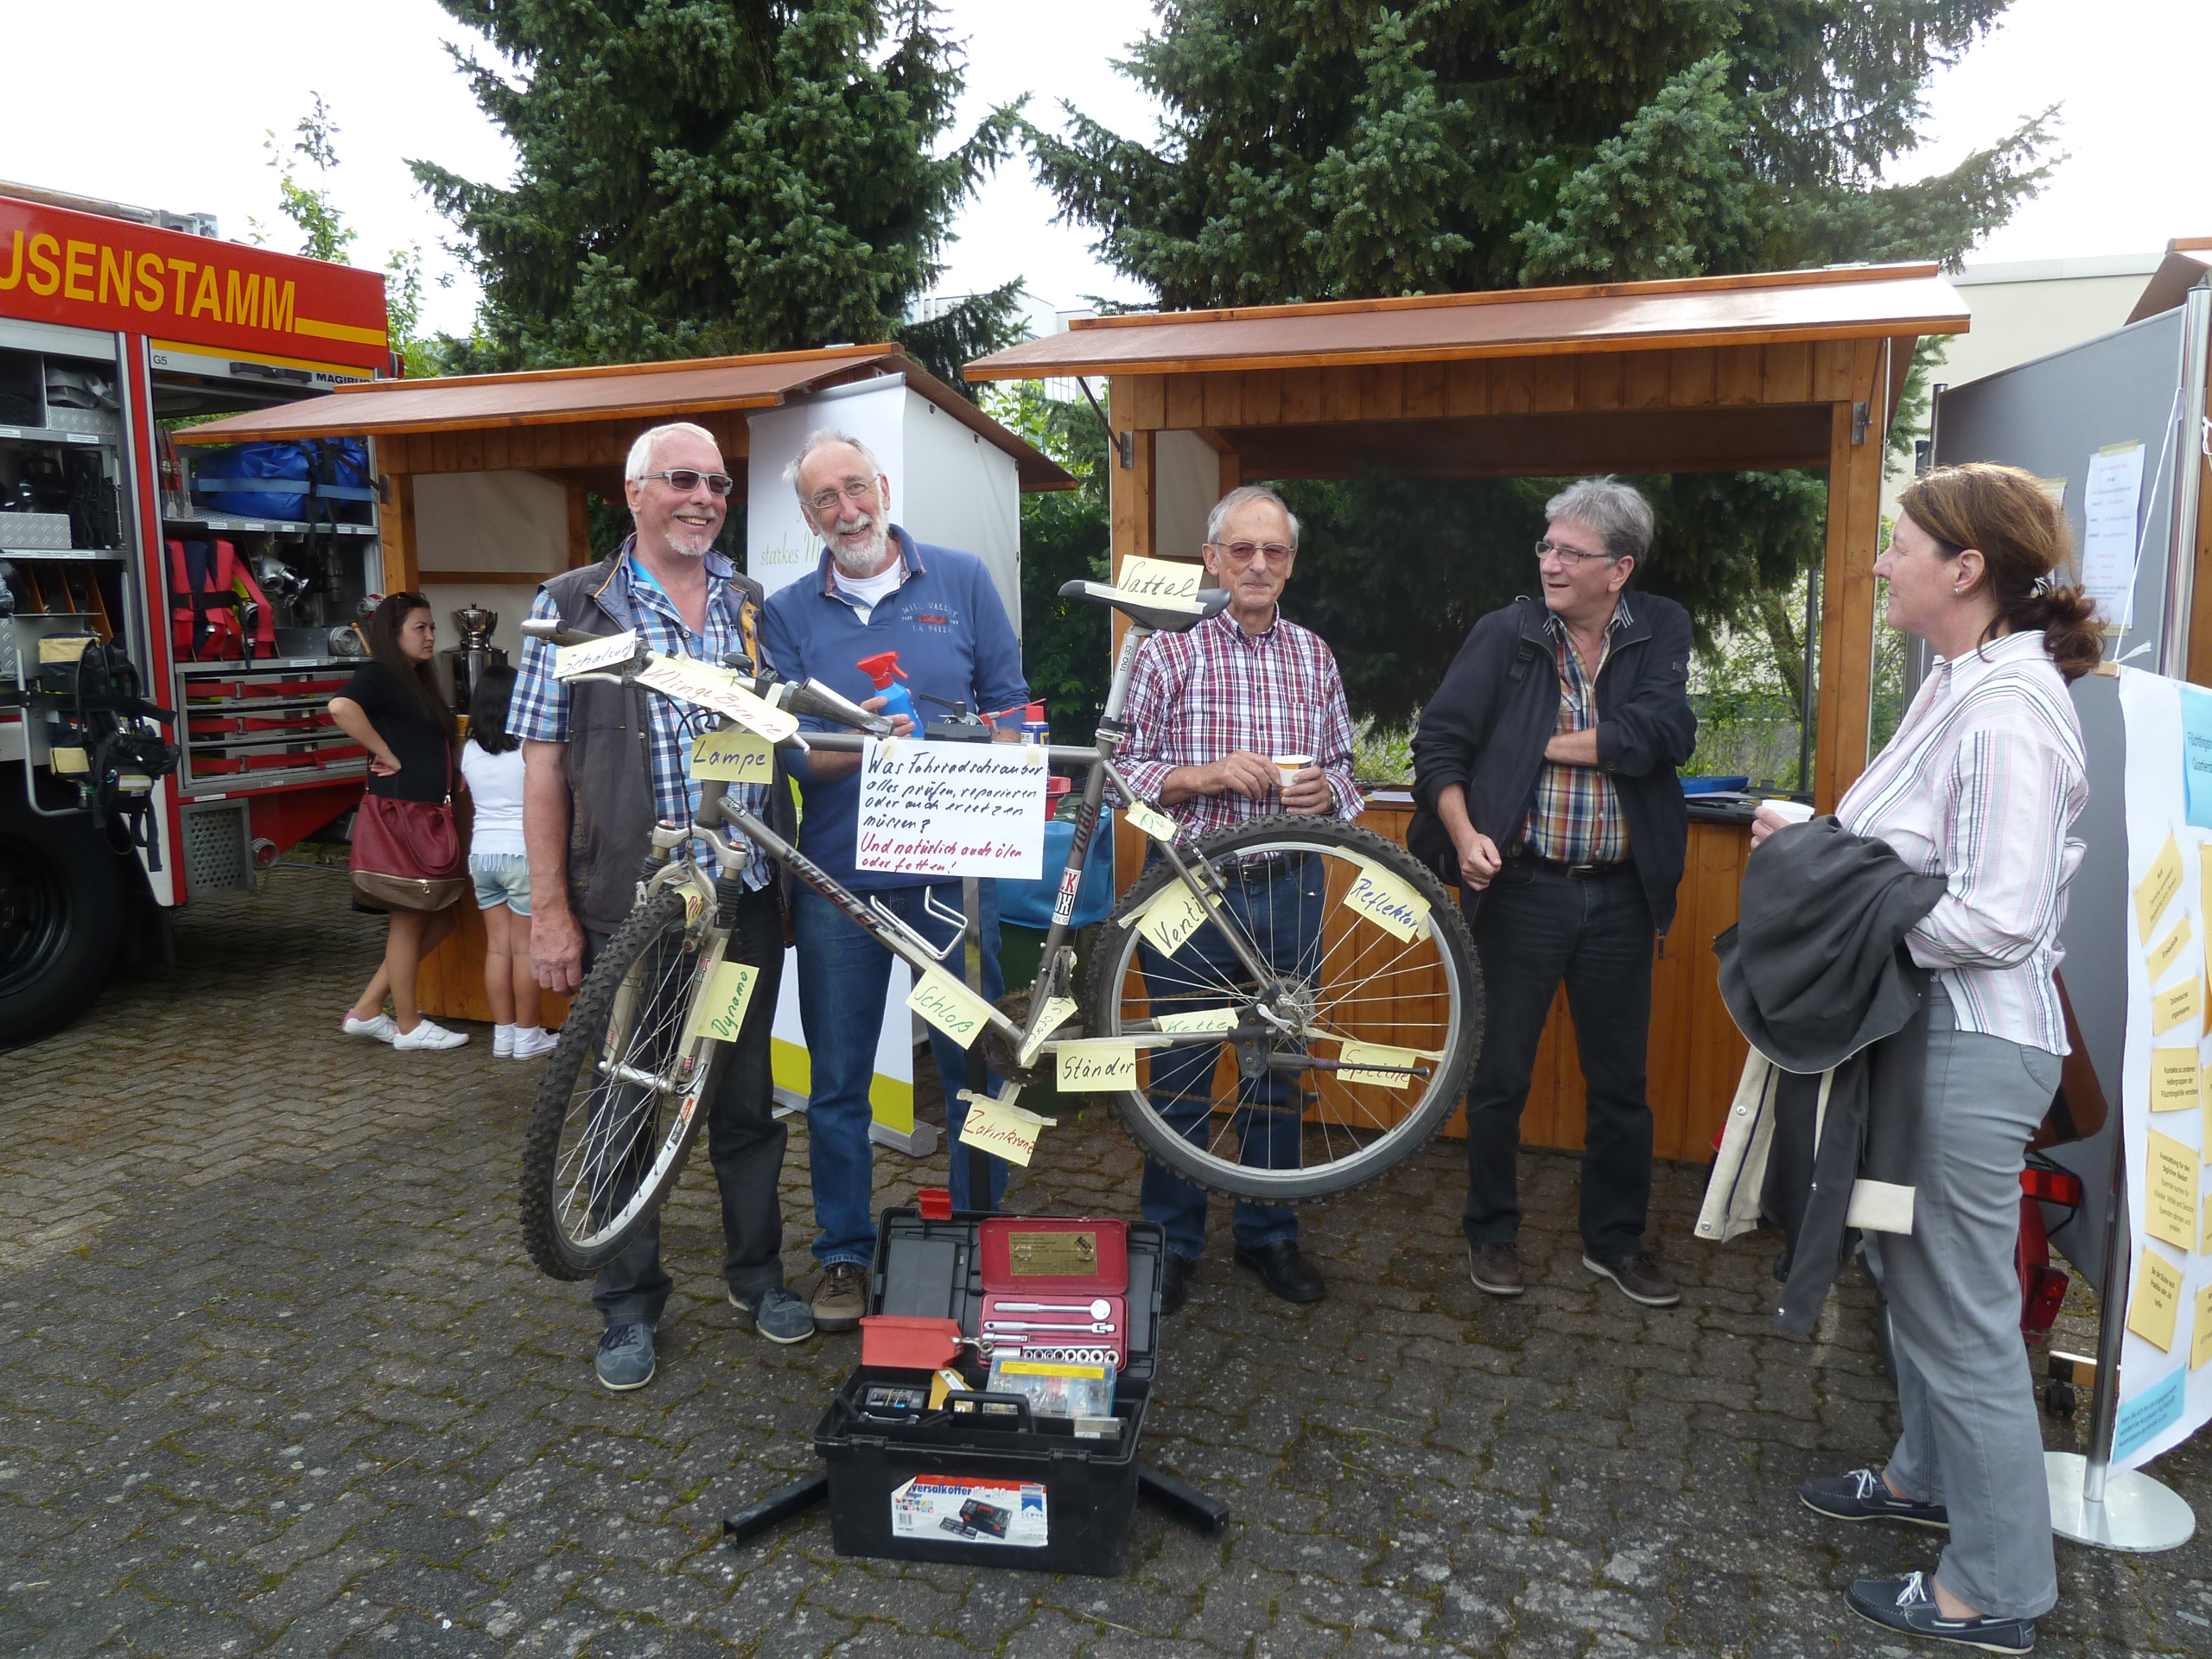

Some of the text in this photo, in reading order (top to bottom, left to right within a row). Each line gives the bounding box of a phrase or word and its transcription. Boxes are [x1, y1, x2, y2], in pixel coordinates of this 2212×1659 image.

[153, 355, 168, 365] G5
[760, 531, 799, 566] starkes
[1119, 562, 1198, 598] Sattel
[693, 740, 766, 775] Lampe
[868, 743, 1044, 775] Was Fahrradschrauber
[867, 779, 899, 793] alles
[960, 787, 1036, 800] reparieren
[905, 800, 938, 810] auch
[945, 802, 1024, 816] ersetzen
[861, 831, 1022, 859] Und natürlich auch ölen
[861, 857, 891, 868] oder
[783, 848, 889, 937] WHEELER
[1350, 878, 1418, 929] Reflektor
[1154, 896, 1205, 950] Venti
[710, 969, 749, 1038] Dynamo
[914, 986, 975, 1033] Schloß
[1166, 1020, 1228, 1033] Kette
[1063, 1056, 1135, 1080] Ständer
[963, 1109, 1036, 1154] Zahnkranz
